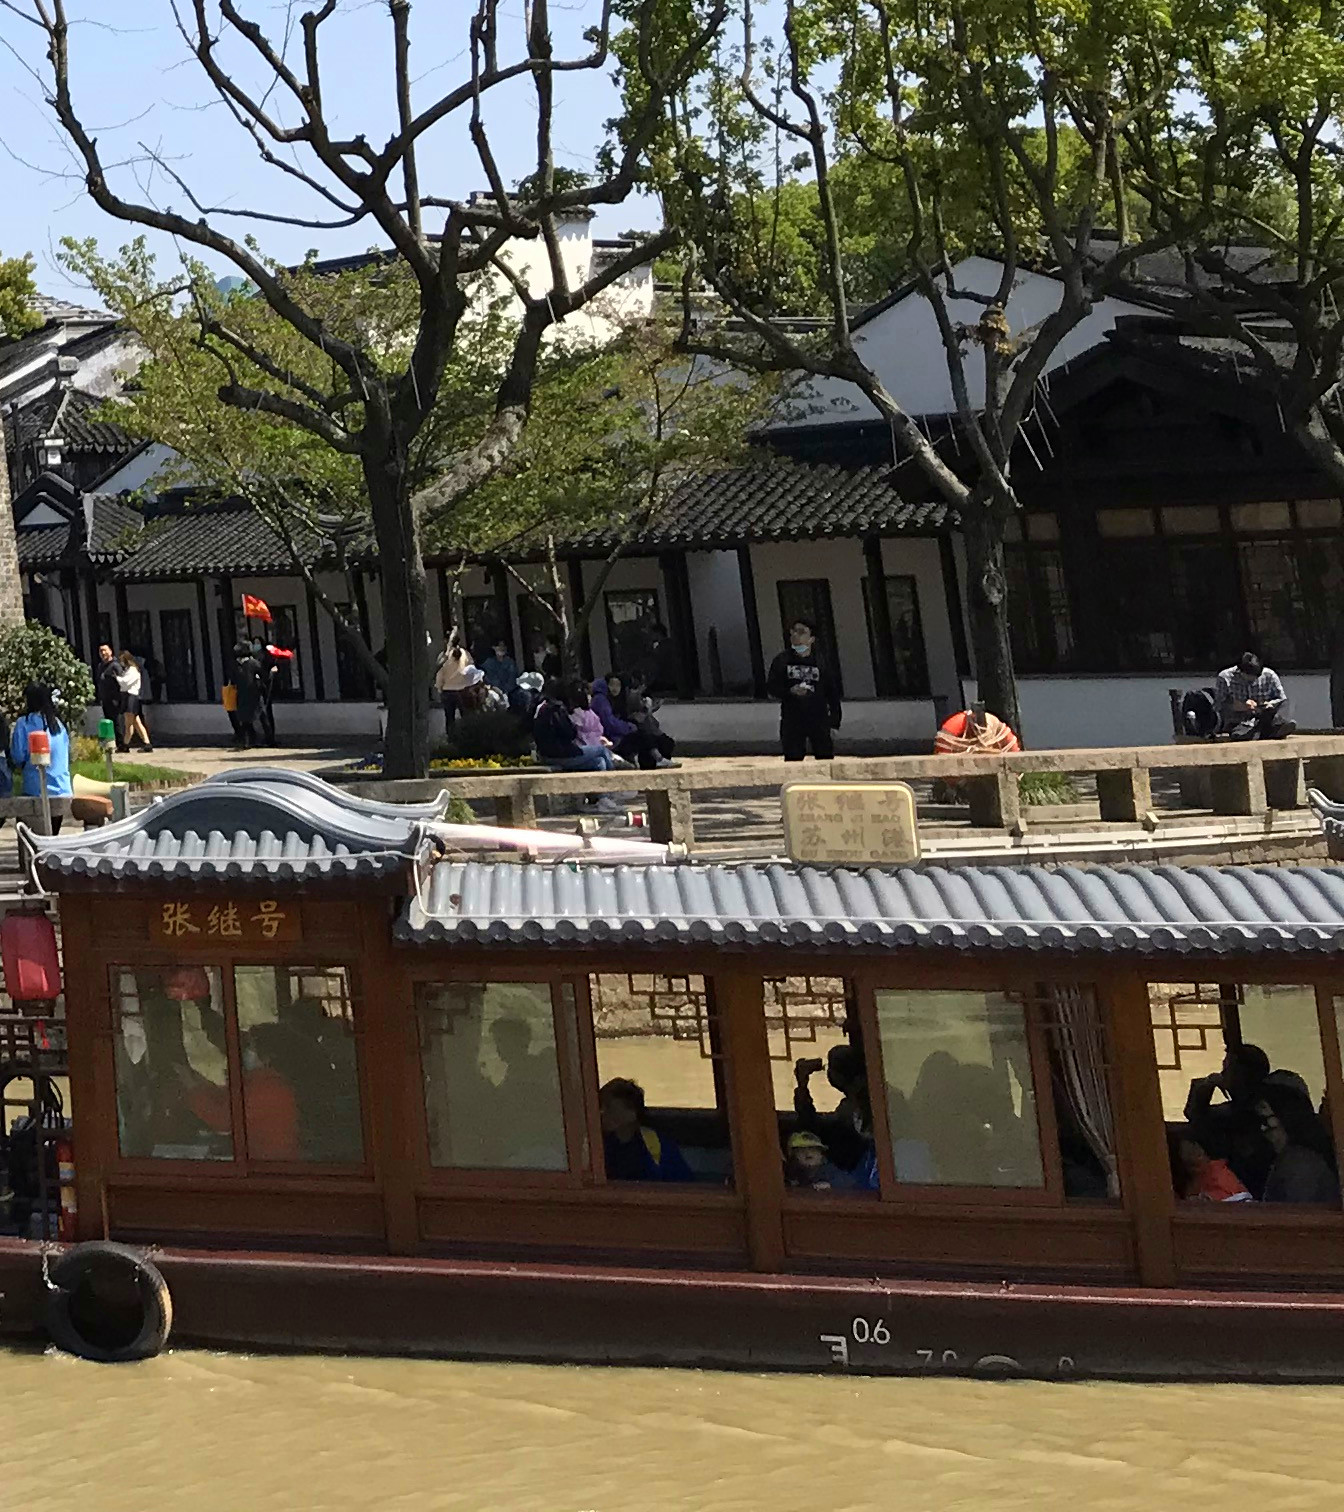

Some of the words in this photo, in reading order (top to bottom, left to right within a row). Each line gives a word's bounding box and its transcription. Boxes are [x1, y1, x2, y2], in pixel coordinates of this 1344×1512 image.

[162, 900, 286, 938] 张继号
[853, 1317, 891, 1344] 0.6
